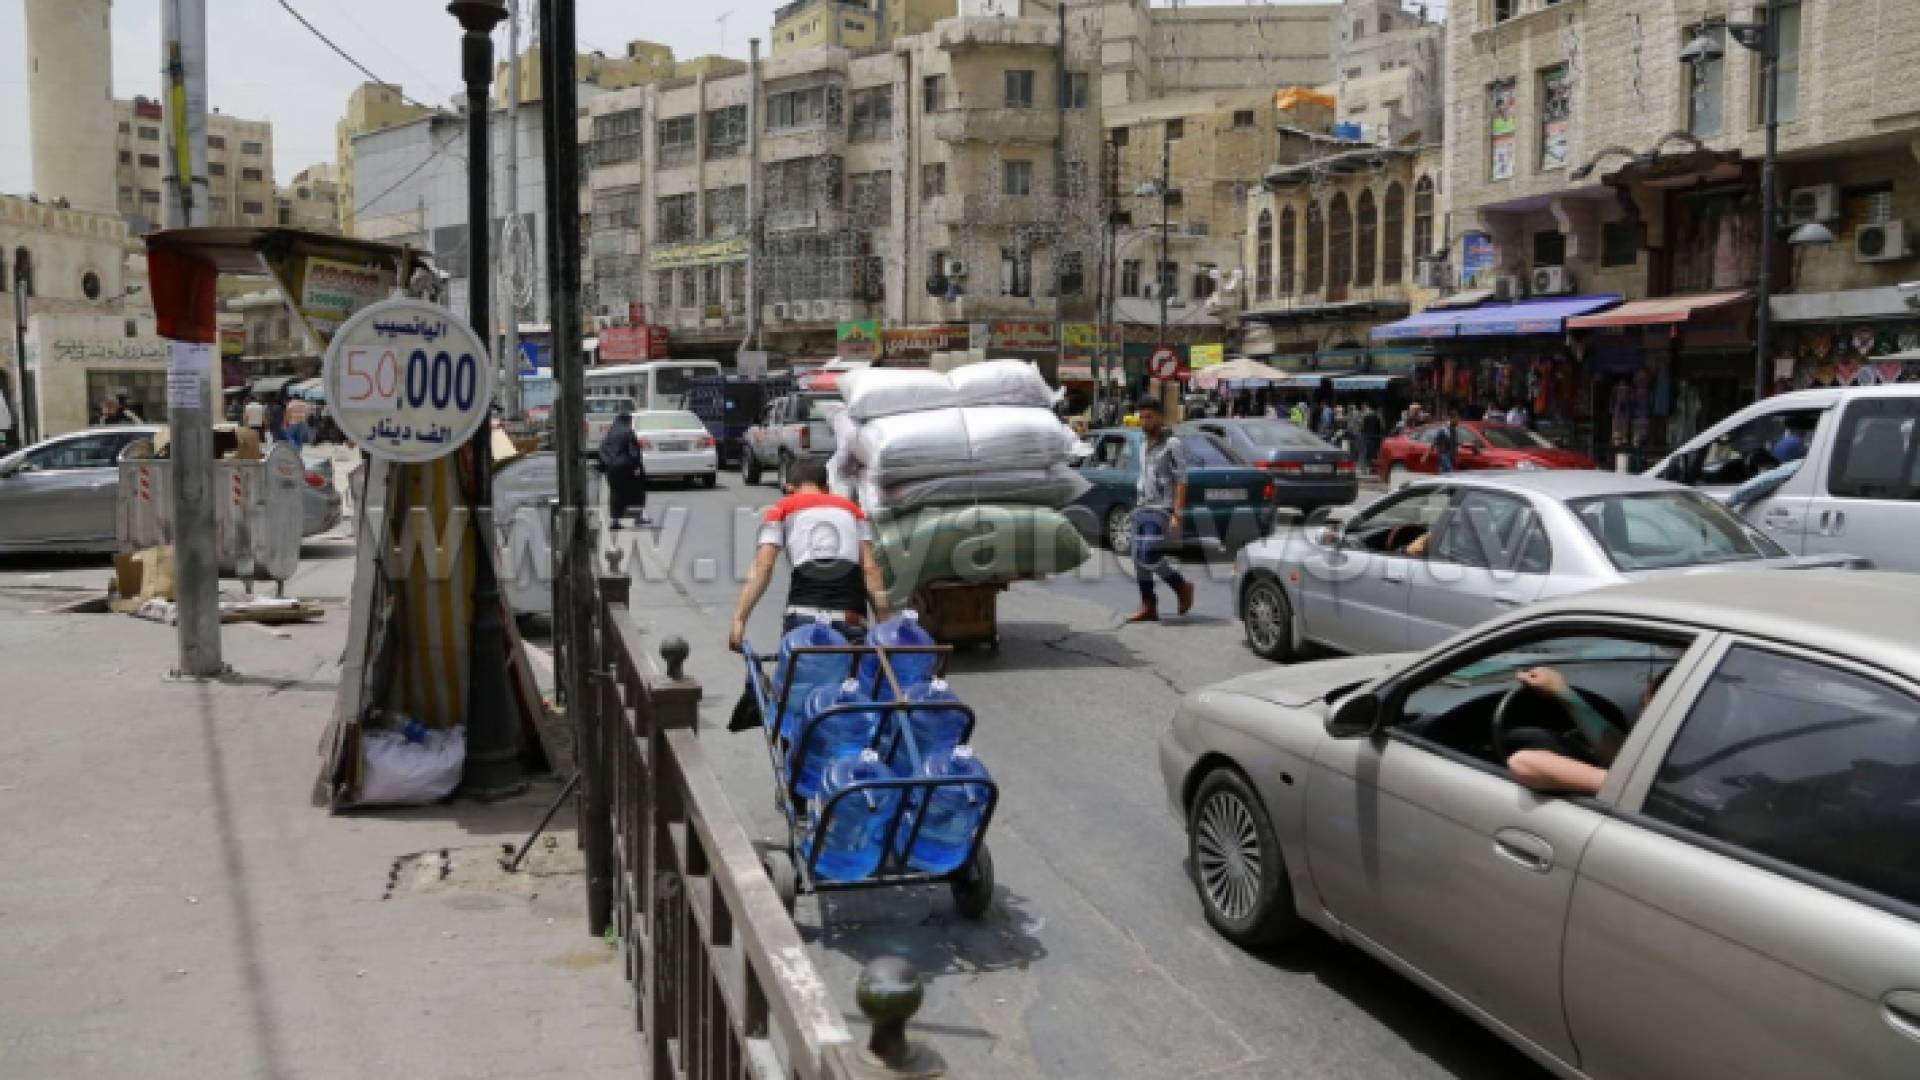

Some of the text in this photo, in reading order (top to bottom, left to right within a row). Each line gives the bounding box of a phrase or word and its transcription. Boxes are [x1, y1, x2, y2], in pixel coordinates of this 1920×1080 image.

[373, 315, 448, 342] اليانصيب
[347, 348, 476, 411] 50,000
[366, 417, 411, 445] دينار
